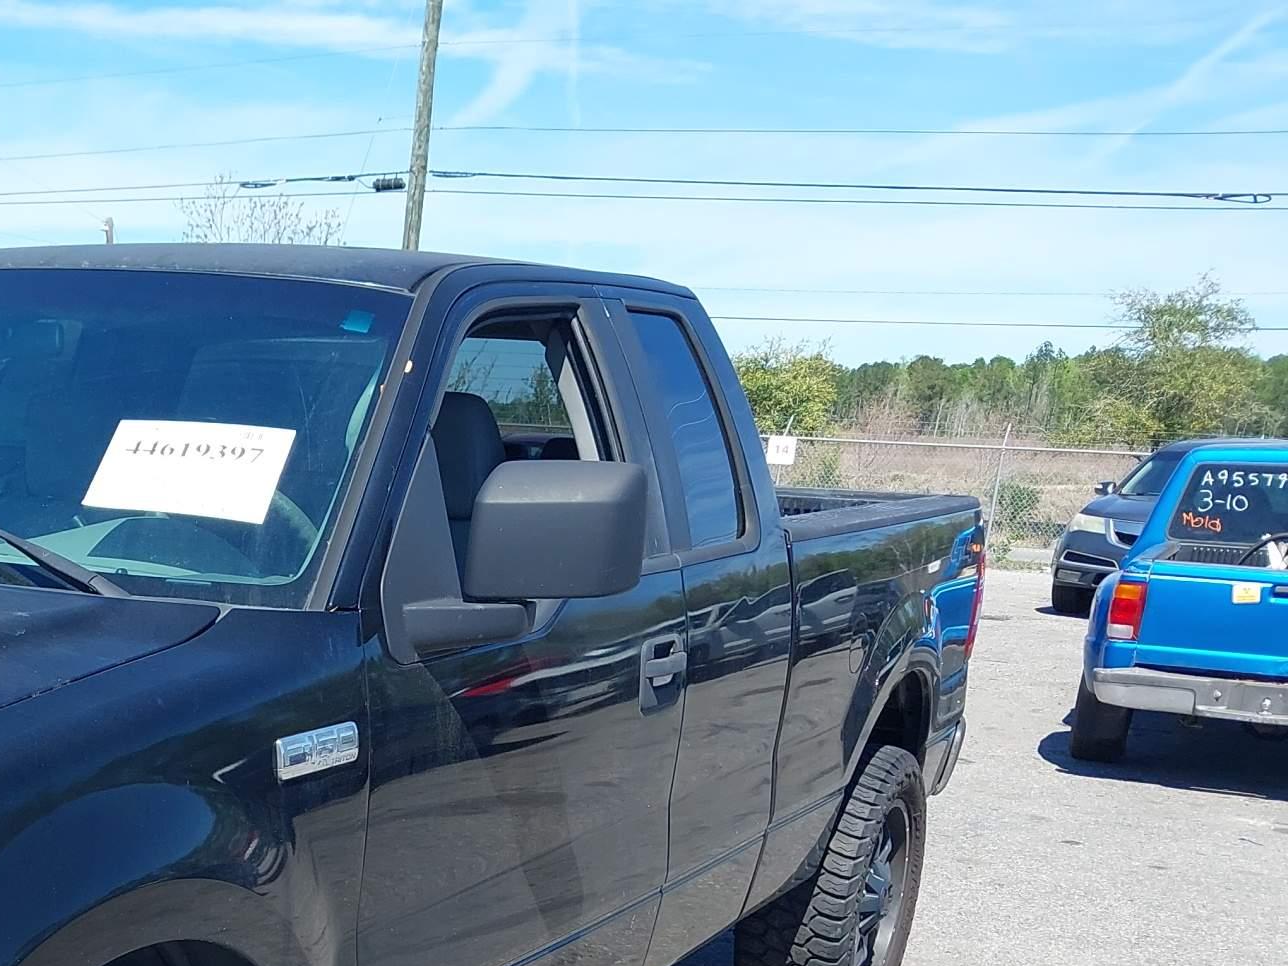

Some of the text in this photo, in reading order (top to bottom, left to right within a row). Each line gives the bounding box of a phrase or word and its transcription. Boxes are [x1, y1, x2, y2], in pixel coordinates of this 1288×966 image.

[124, 440, 265, 463] 44619397
[775, 444, 789, 455] 14
[1197, 489, 1249, 512] 3-10
